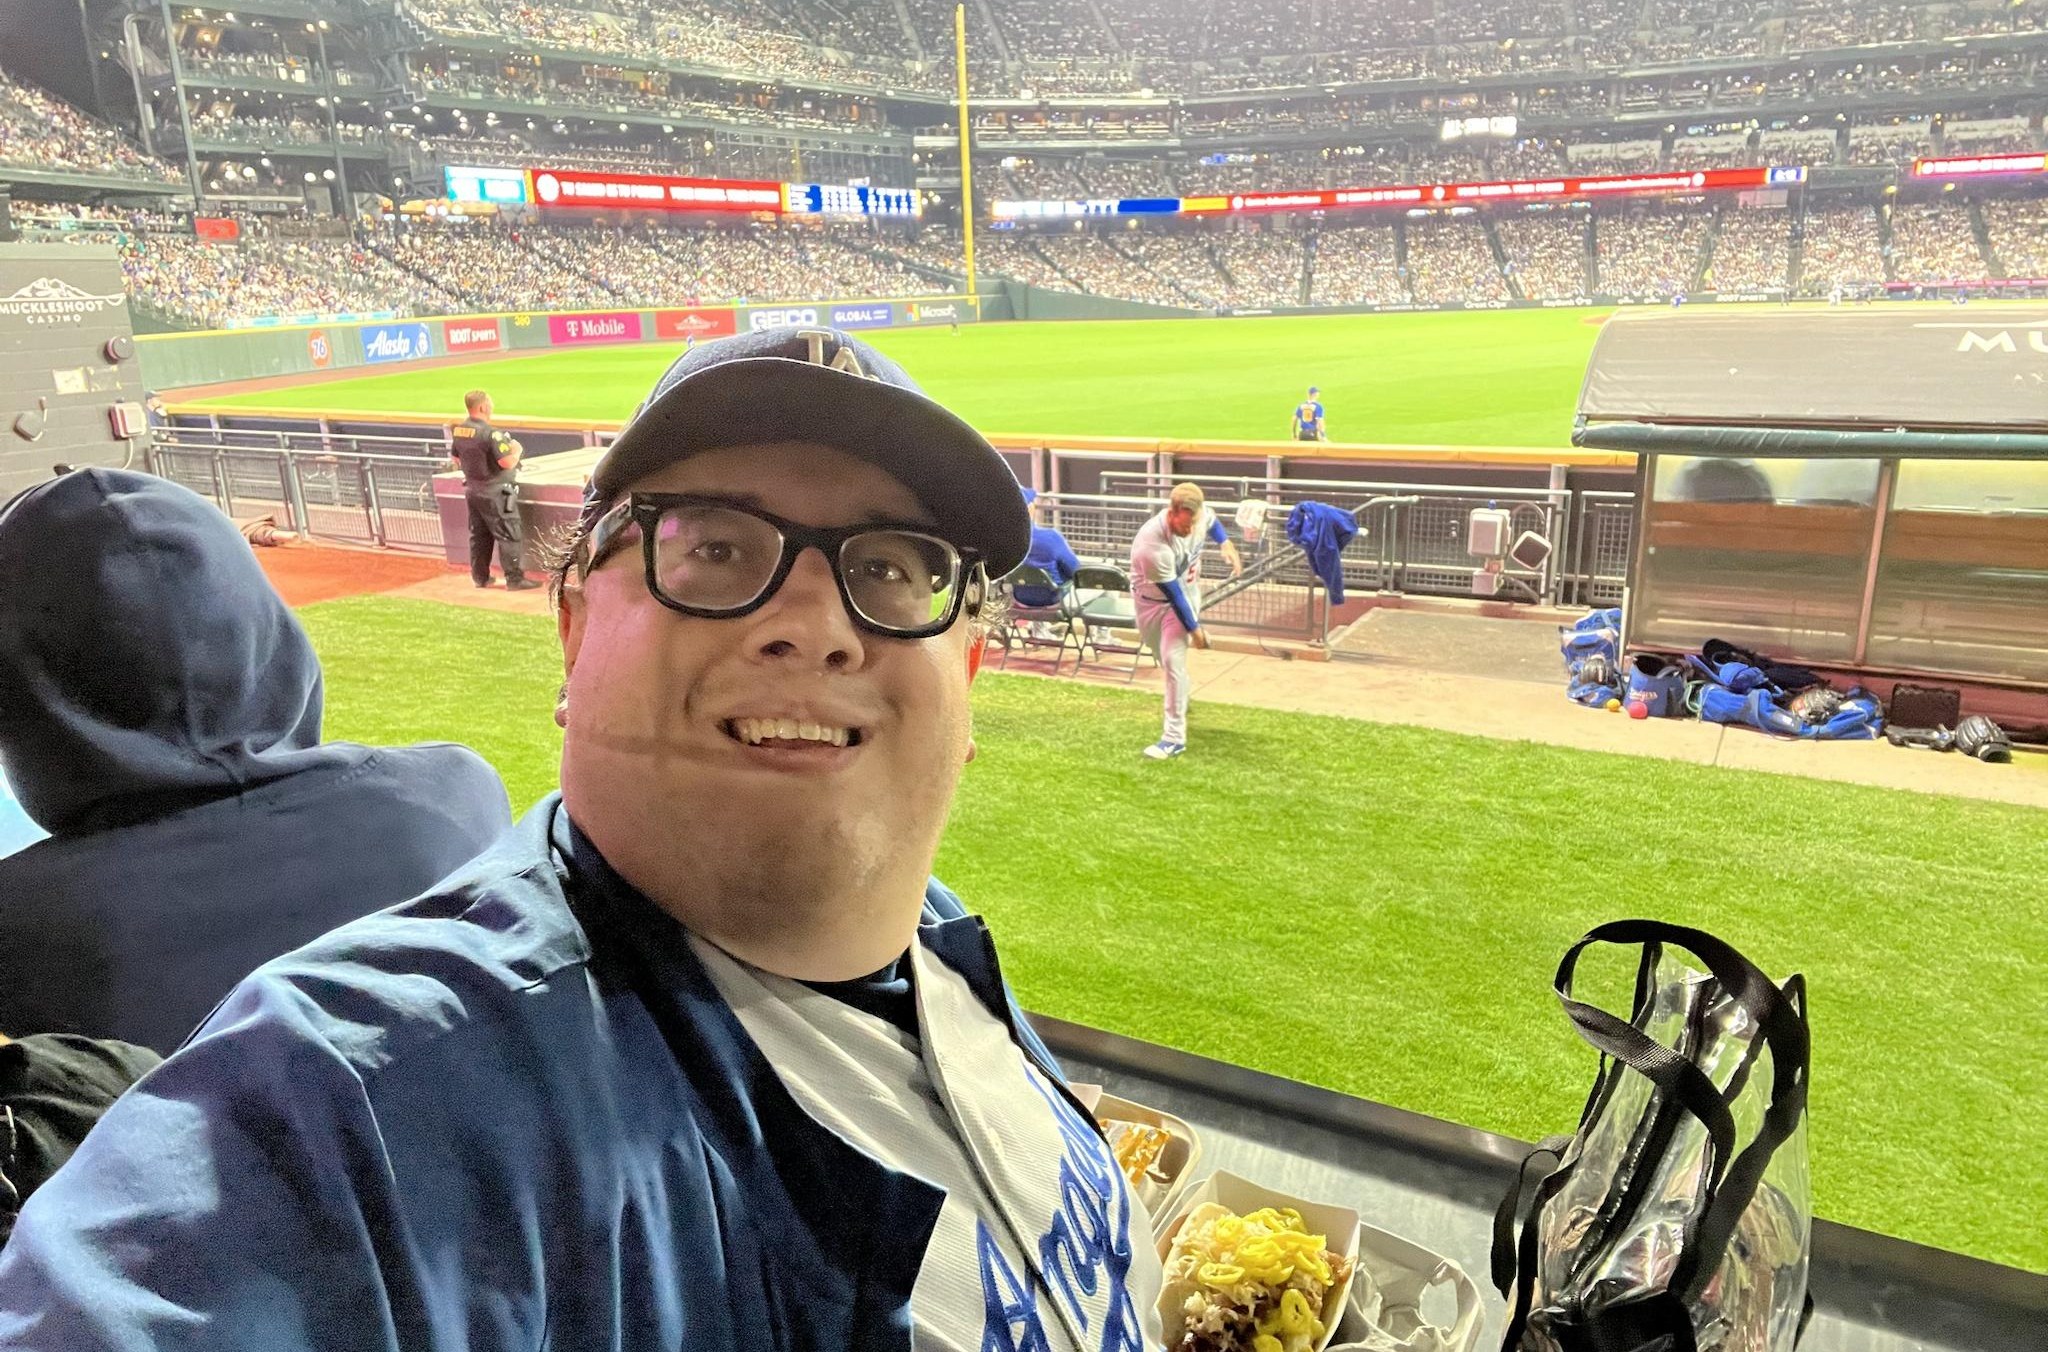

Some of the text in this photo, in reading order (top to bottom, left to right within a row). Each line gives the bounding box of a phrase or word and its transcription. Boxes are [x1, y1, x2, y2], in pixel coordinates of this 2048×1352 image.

[0, 300, 104, 314] MUCKLESHOOT
[26, 314, 82, 324] CASINO
[749, 308, 818, 330] GEICO
[834, 310, 872, 322] GLOBAL
[582, 319, 625, 336] Mobile
[367, 329, 410, 358] Alaska
[449, 328, 496, 344] ROOT SPORTS
[310, 337, 328, 359] 76
